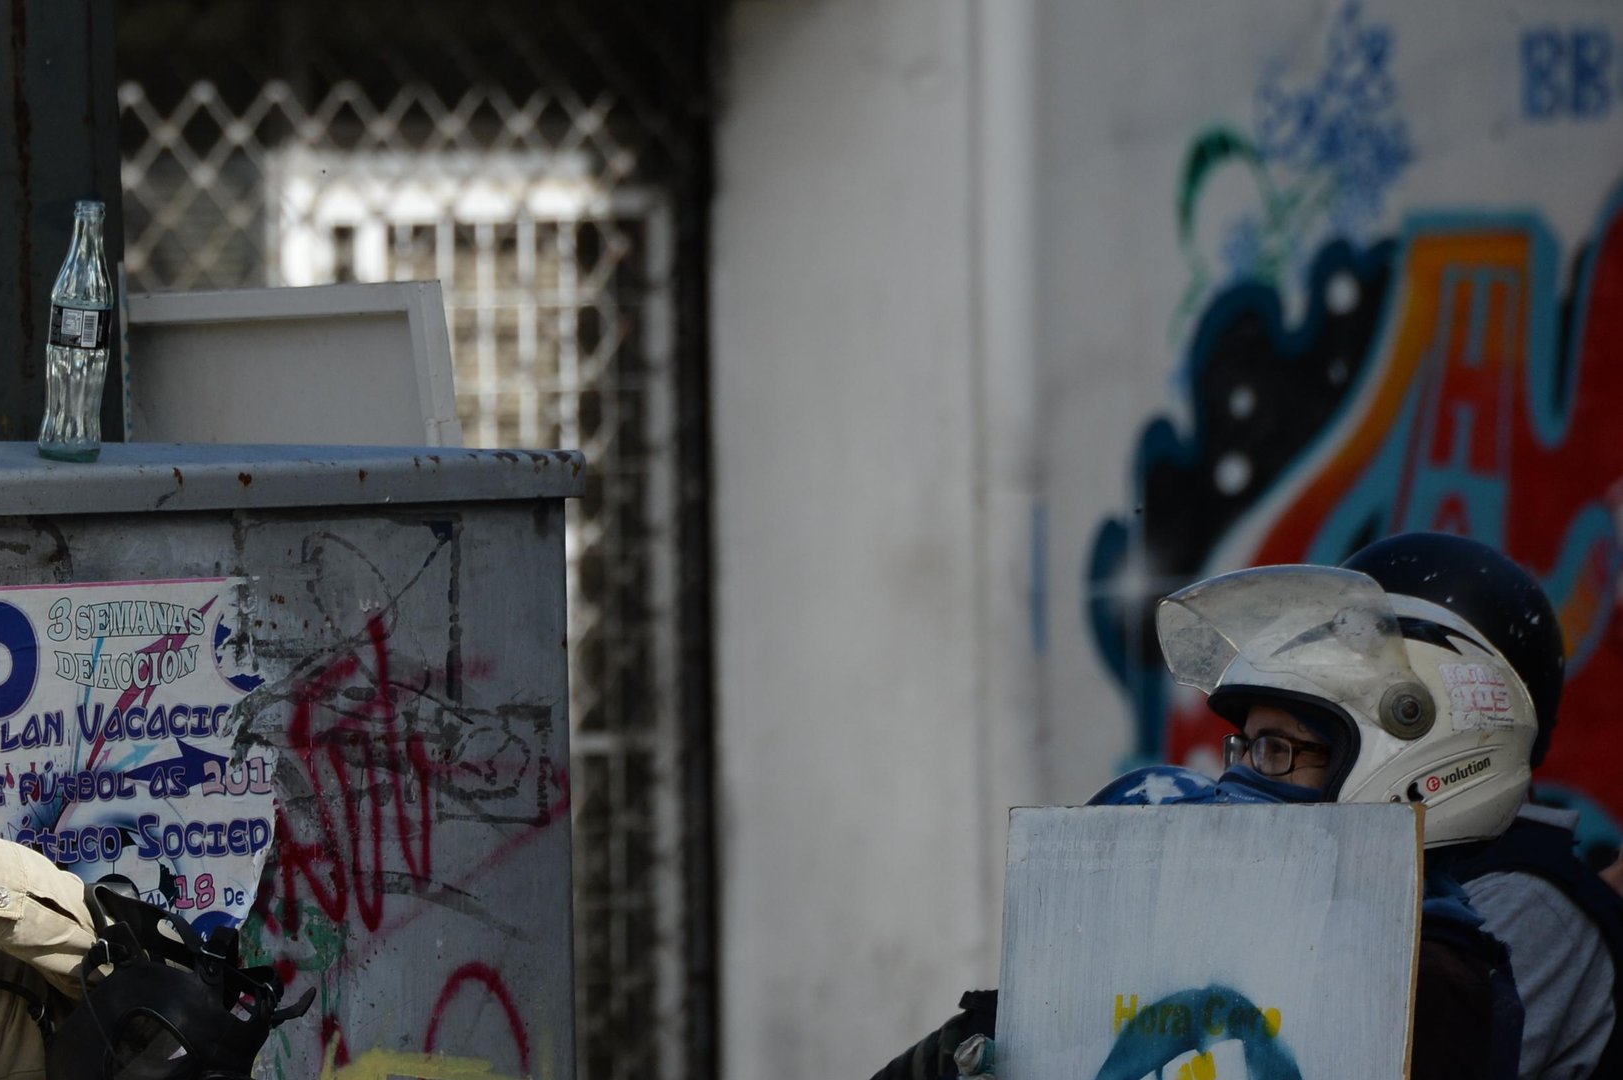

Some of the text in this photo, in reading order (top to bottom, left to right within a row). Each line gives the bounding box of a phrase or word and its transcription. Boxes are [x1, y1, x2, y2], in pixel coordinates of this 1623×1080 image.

[46, 597, 206, 641] 3 SEMANAS
[54, 637, 200, 691] DE ACCIÓN
[174, 873, 215, 910] 18
